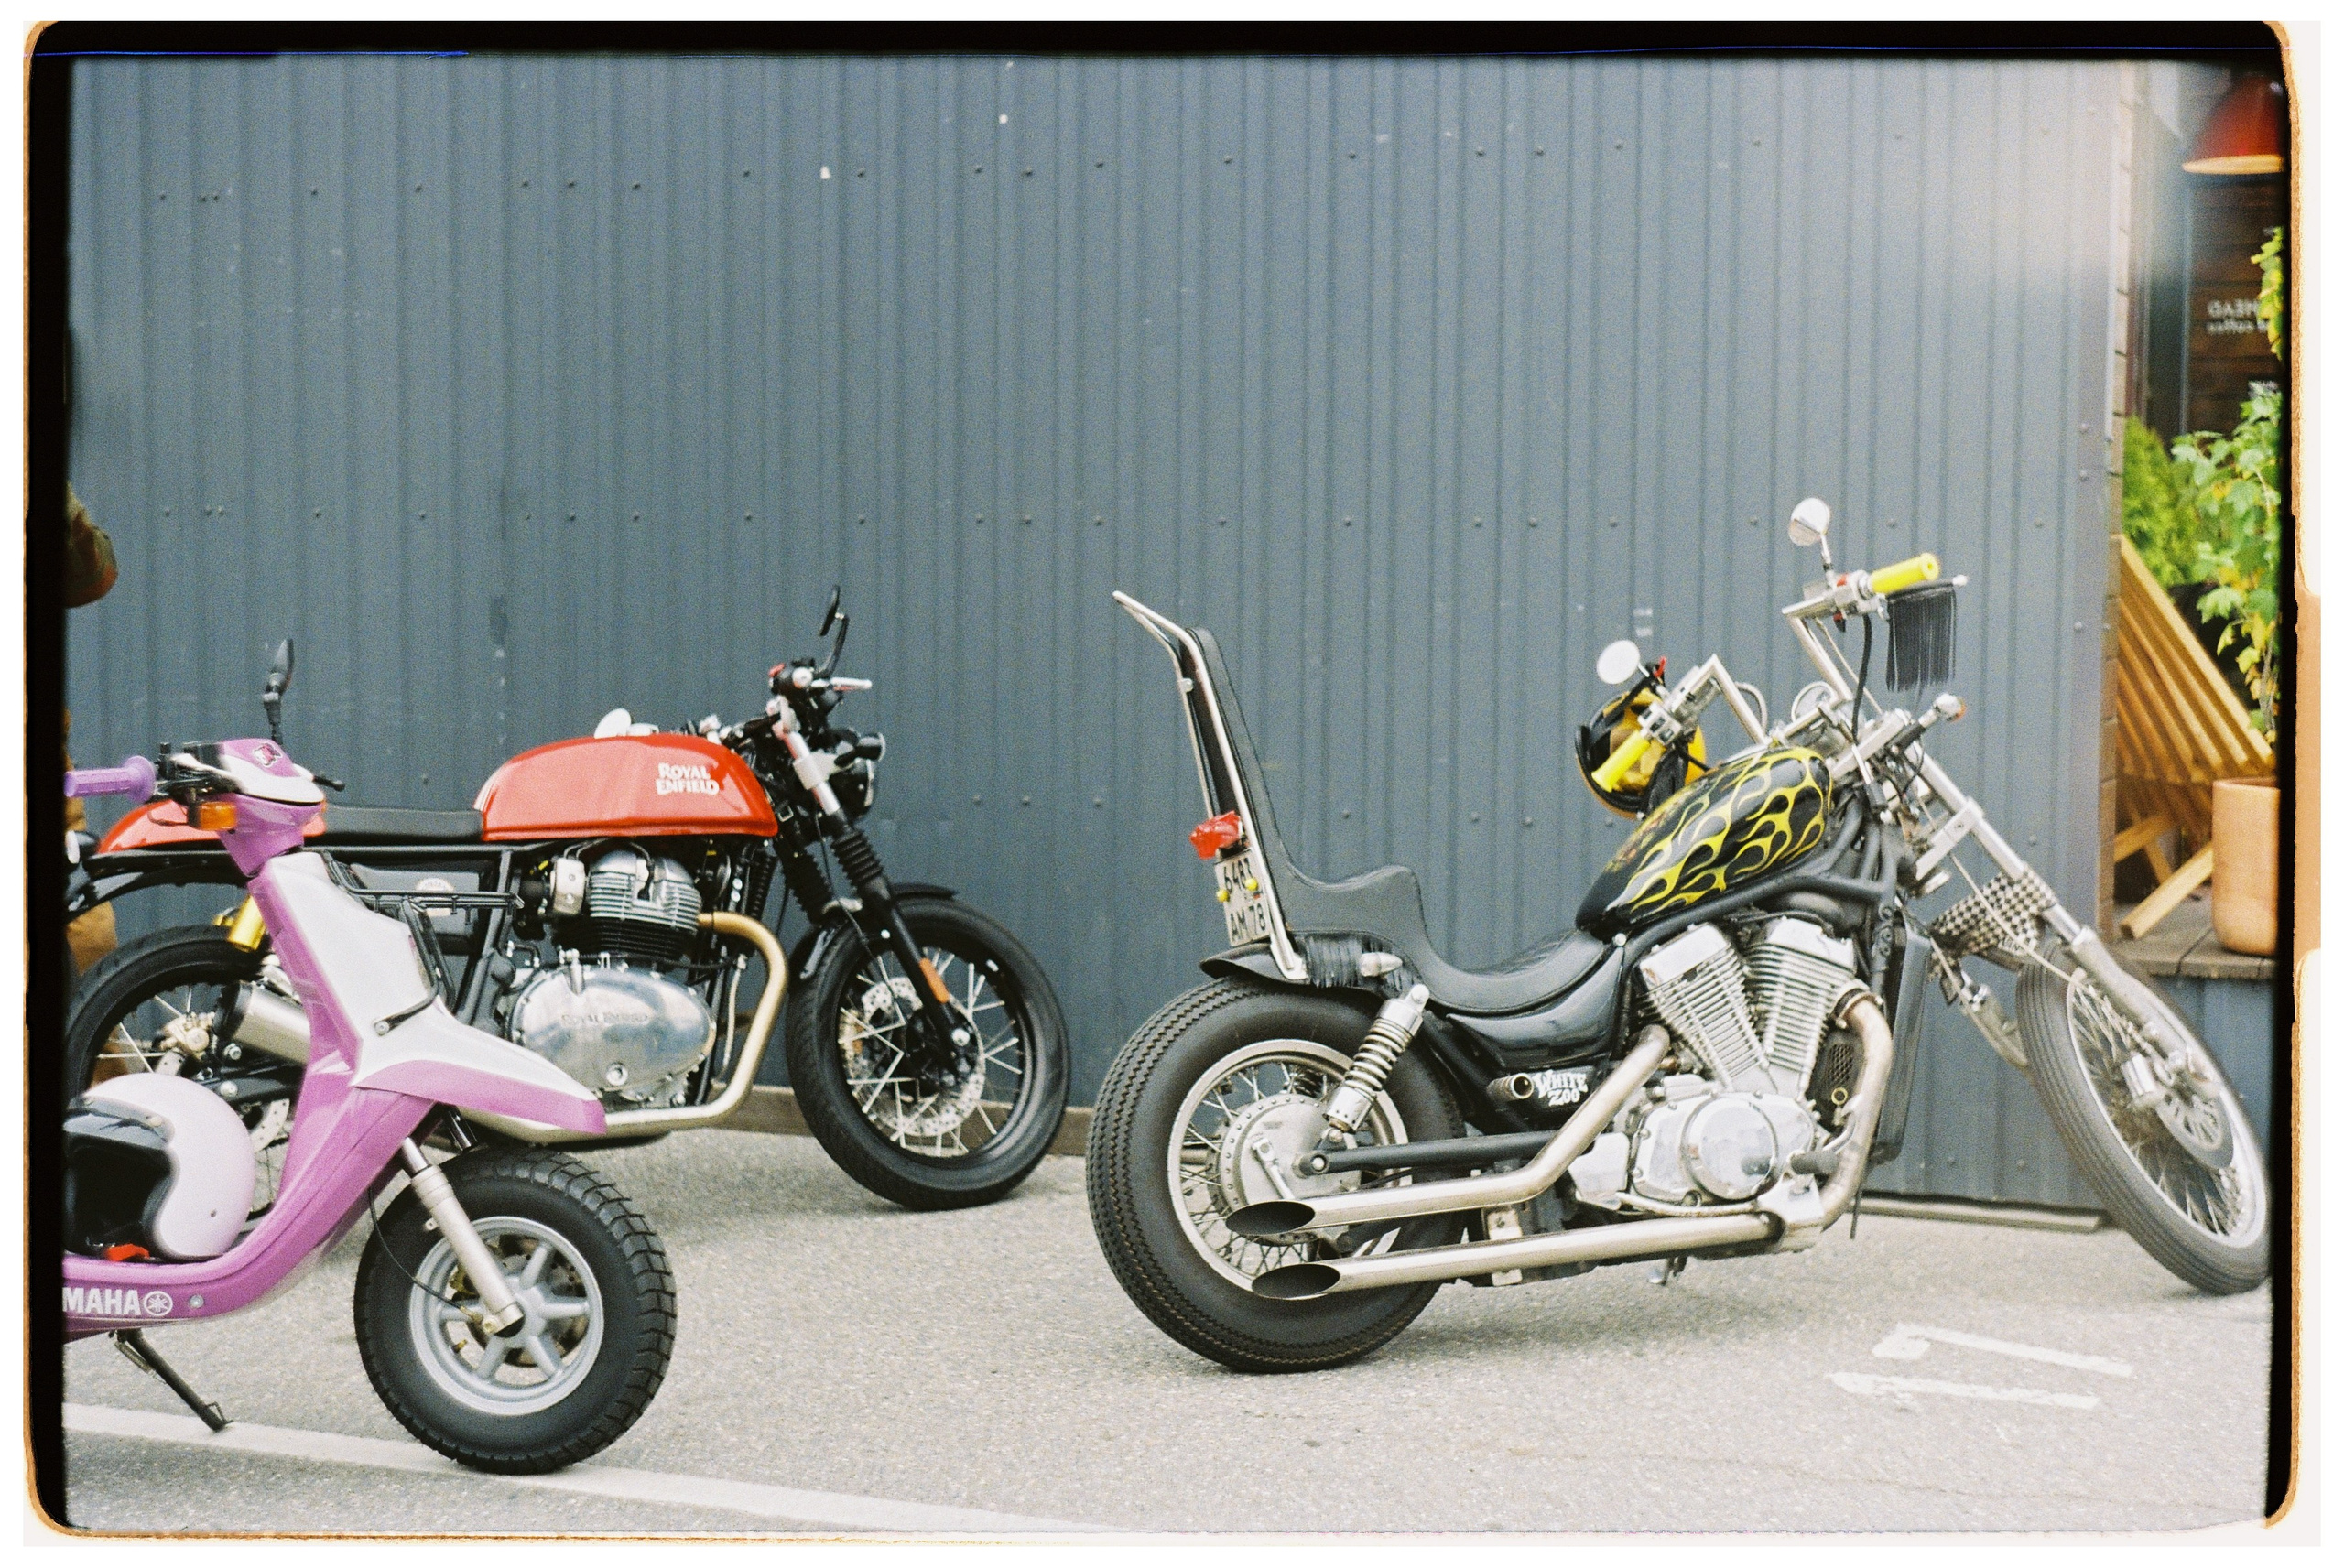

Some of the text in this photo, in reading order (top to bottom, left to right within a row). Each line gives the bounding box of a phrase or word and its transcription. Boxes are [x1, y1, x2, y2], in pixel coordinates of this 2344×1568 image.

[658, 762, 711, 780] ROYAL
[656, 779, 720, 795] ENFIELD
[1249, 903, 1266, 935] 78
[1531, 1069, 1589, 1098] WHITE
[1547, 1088, 1581, 1107] ZOO
[61, 1286, 142, 1316] MAHA
